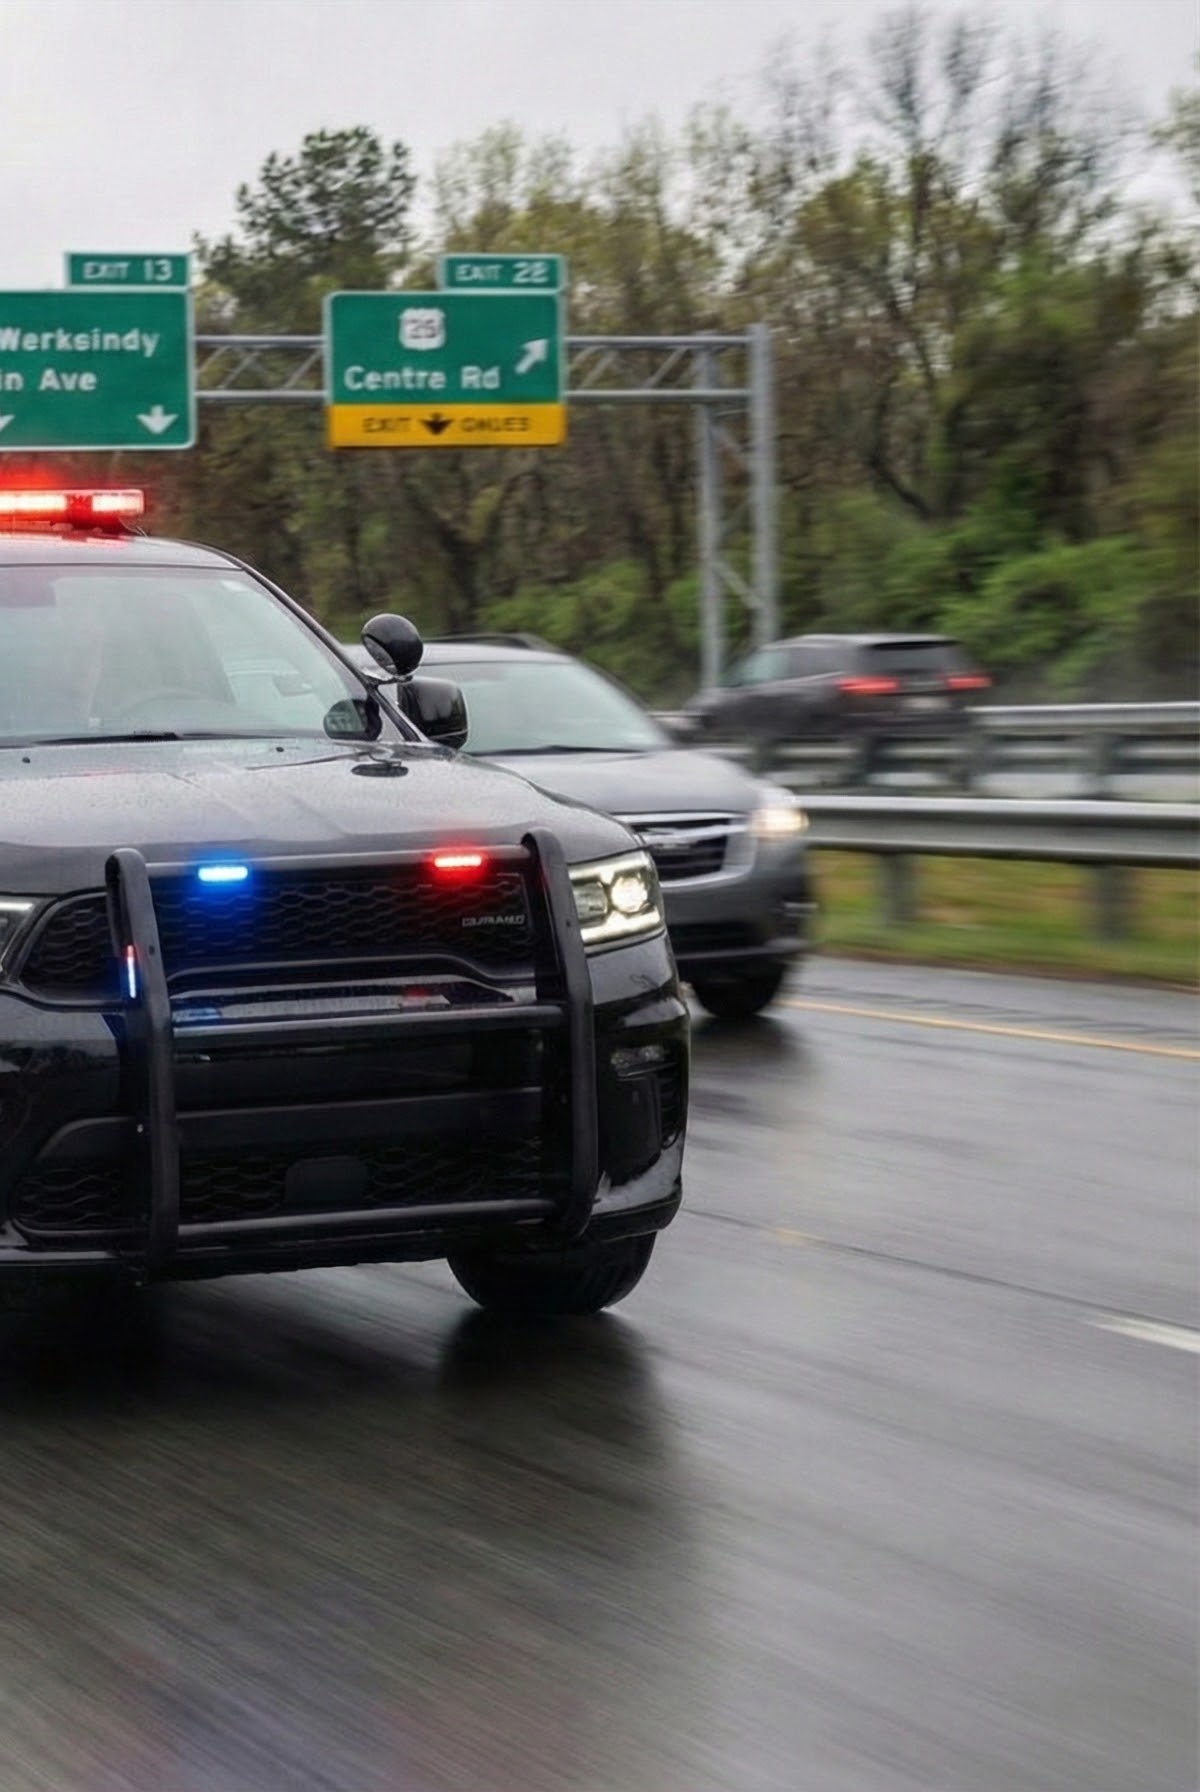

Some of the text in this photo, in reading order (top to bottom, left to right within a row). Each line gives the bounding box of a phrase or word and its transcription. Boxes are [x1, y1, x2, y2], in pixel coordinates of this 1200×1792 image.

[144, 259, 172, 281] 13
[39, 367, 97, 391] Ave
[344, 365, 500, 391] Centre Rd
